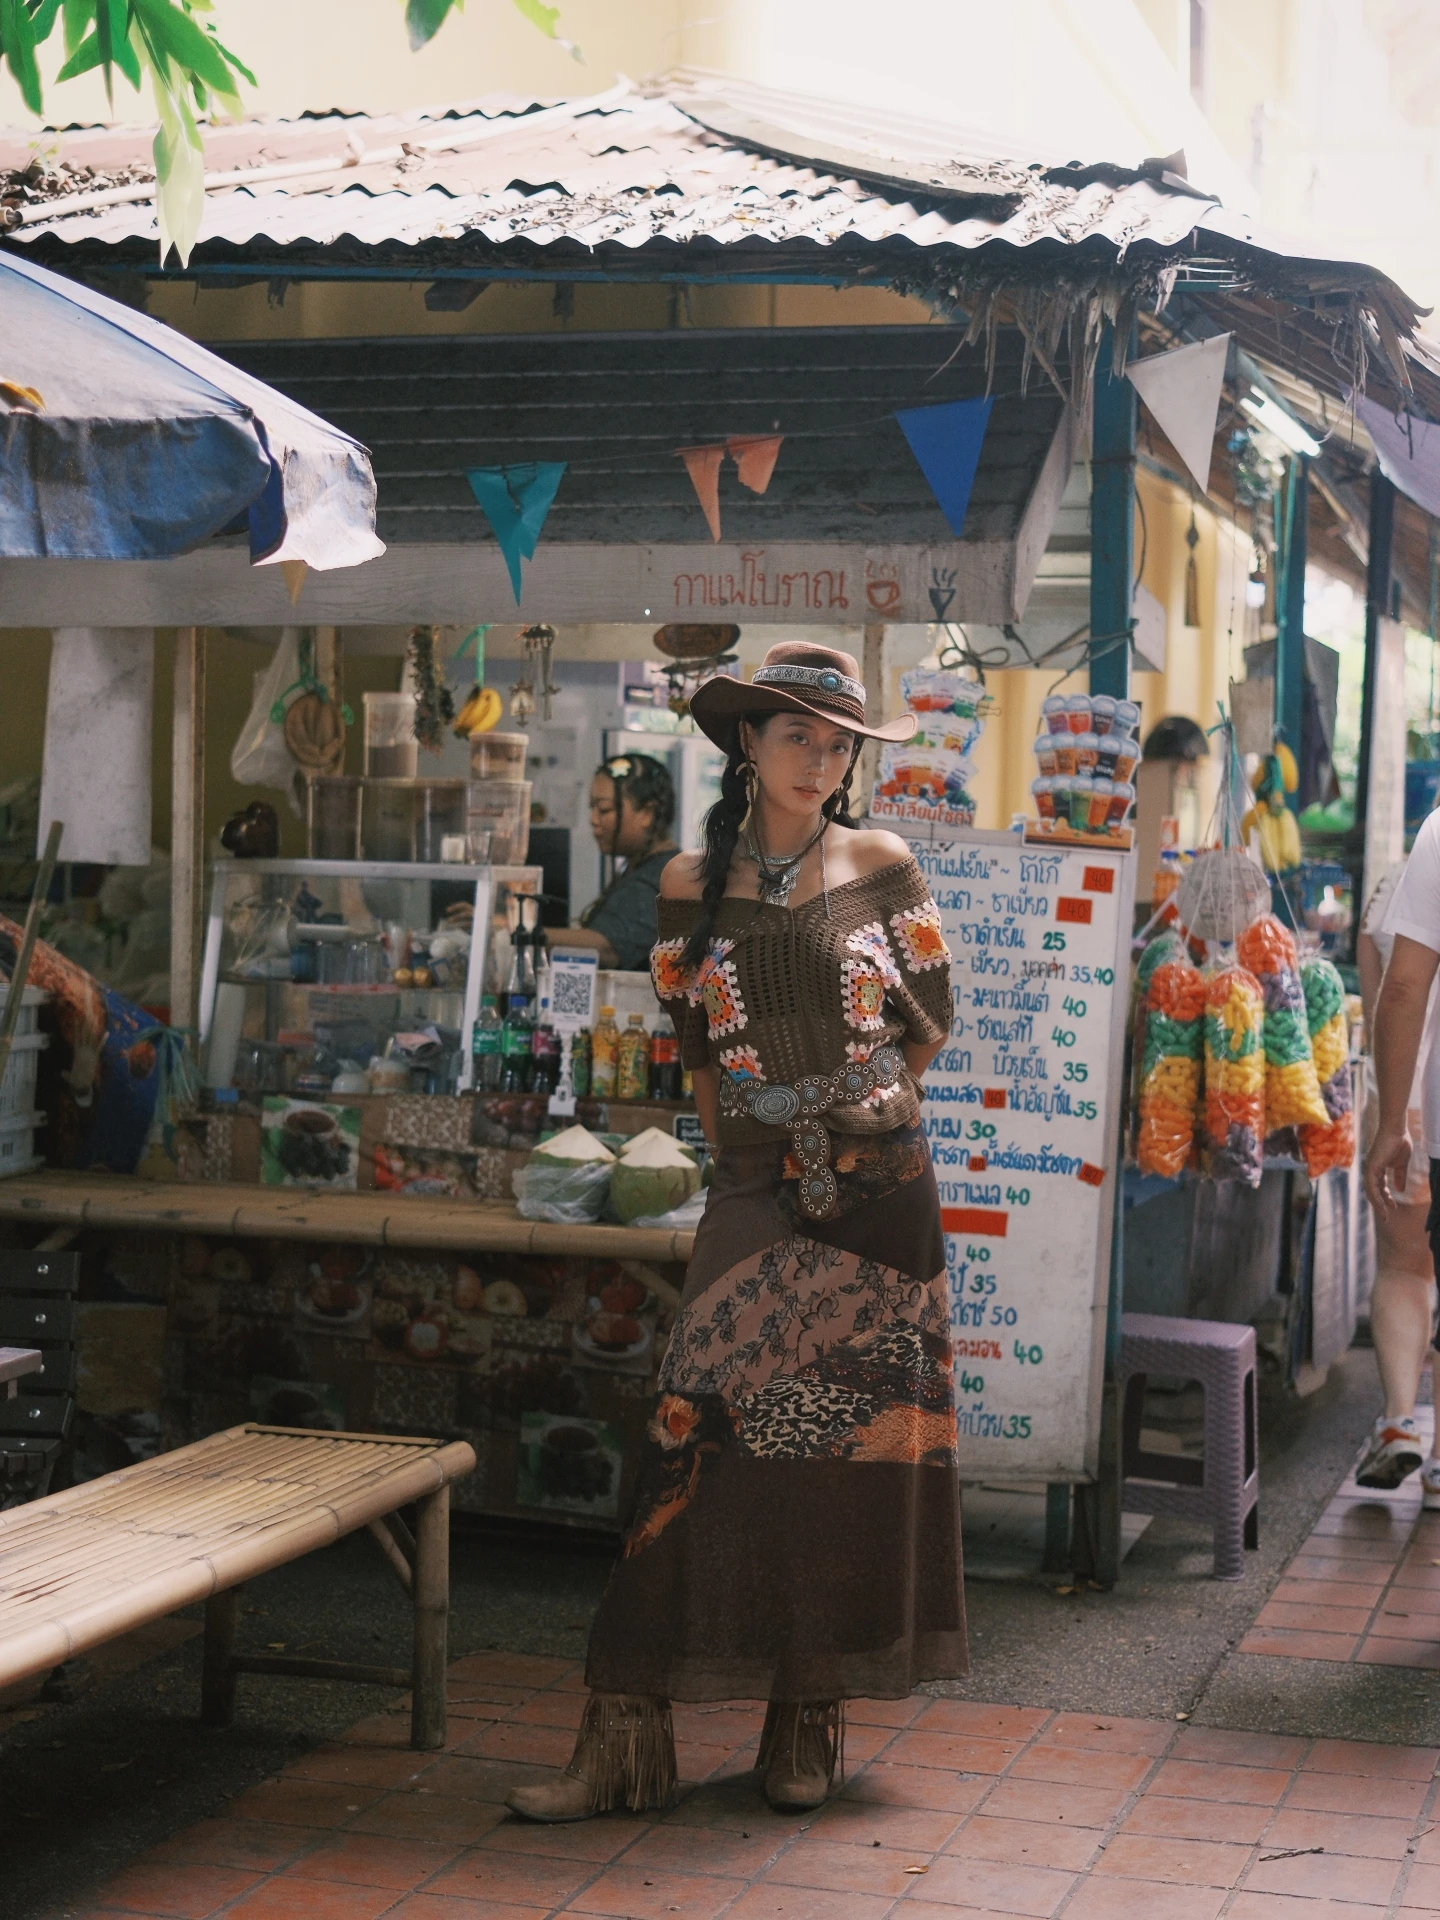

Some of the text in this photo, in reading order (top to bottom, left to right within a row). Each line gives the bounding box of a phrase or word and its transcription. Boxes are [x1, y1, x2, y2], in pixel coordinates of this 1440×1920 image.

[673, 550, 849, 609] กาแฟโบราณ
[991, 885, 1049, 916] ชาเขียว
[1067, 901, 1086, 919] 40
[1042, 931, 1066, 951] 25
[1062, 994, 1087, 1018] 40
[1051, 1025, 1077, 1048] 40
[1063, 1061, 1089, 1082] 35
[1072, 1100, 1098, 1120] 35
[965, 1119, 997, 1141] 30
[1005, 1185, 1031, 1206] 40
[965, 1243, 991, 1263] 40
[969, 1274, 997, 1295] 35
[990, 1304, 1018, 1326] 50
[1013, 1338, 1043, 1365] 40
[960, 1370, 985, 1394] 40
[1002, 1414, 1032, 1439] 35
